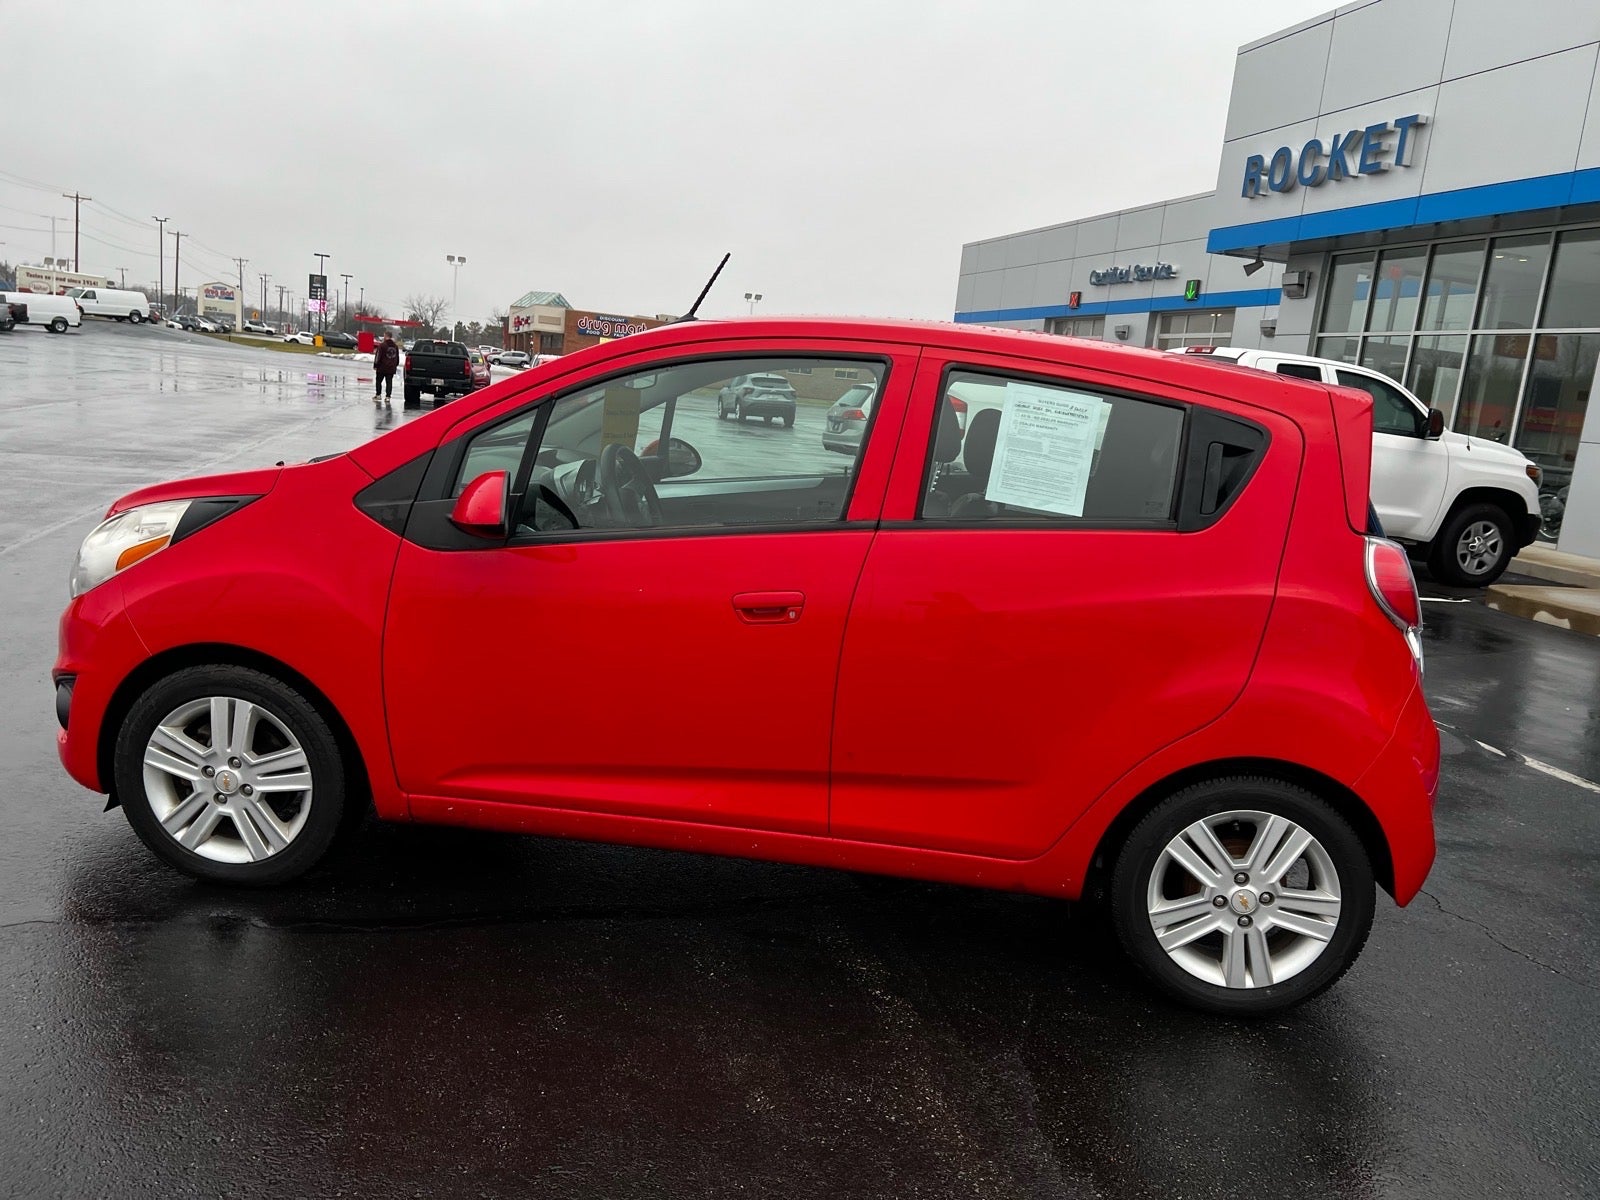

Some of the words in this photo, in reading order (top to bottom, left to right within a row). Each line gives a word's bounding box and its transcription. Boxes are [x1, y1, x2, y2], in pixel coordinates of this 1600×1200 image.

[1242, 114, 1426, 198] ROCKET
[1090, 265, 1133, 286] Certified
[1133, 262, 1176, 281] Service
[577, 316, 612, 337] drug
[614, 322, 648, 335] mart
[599, 315, 625, 323] DISCOUNT
